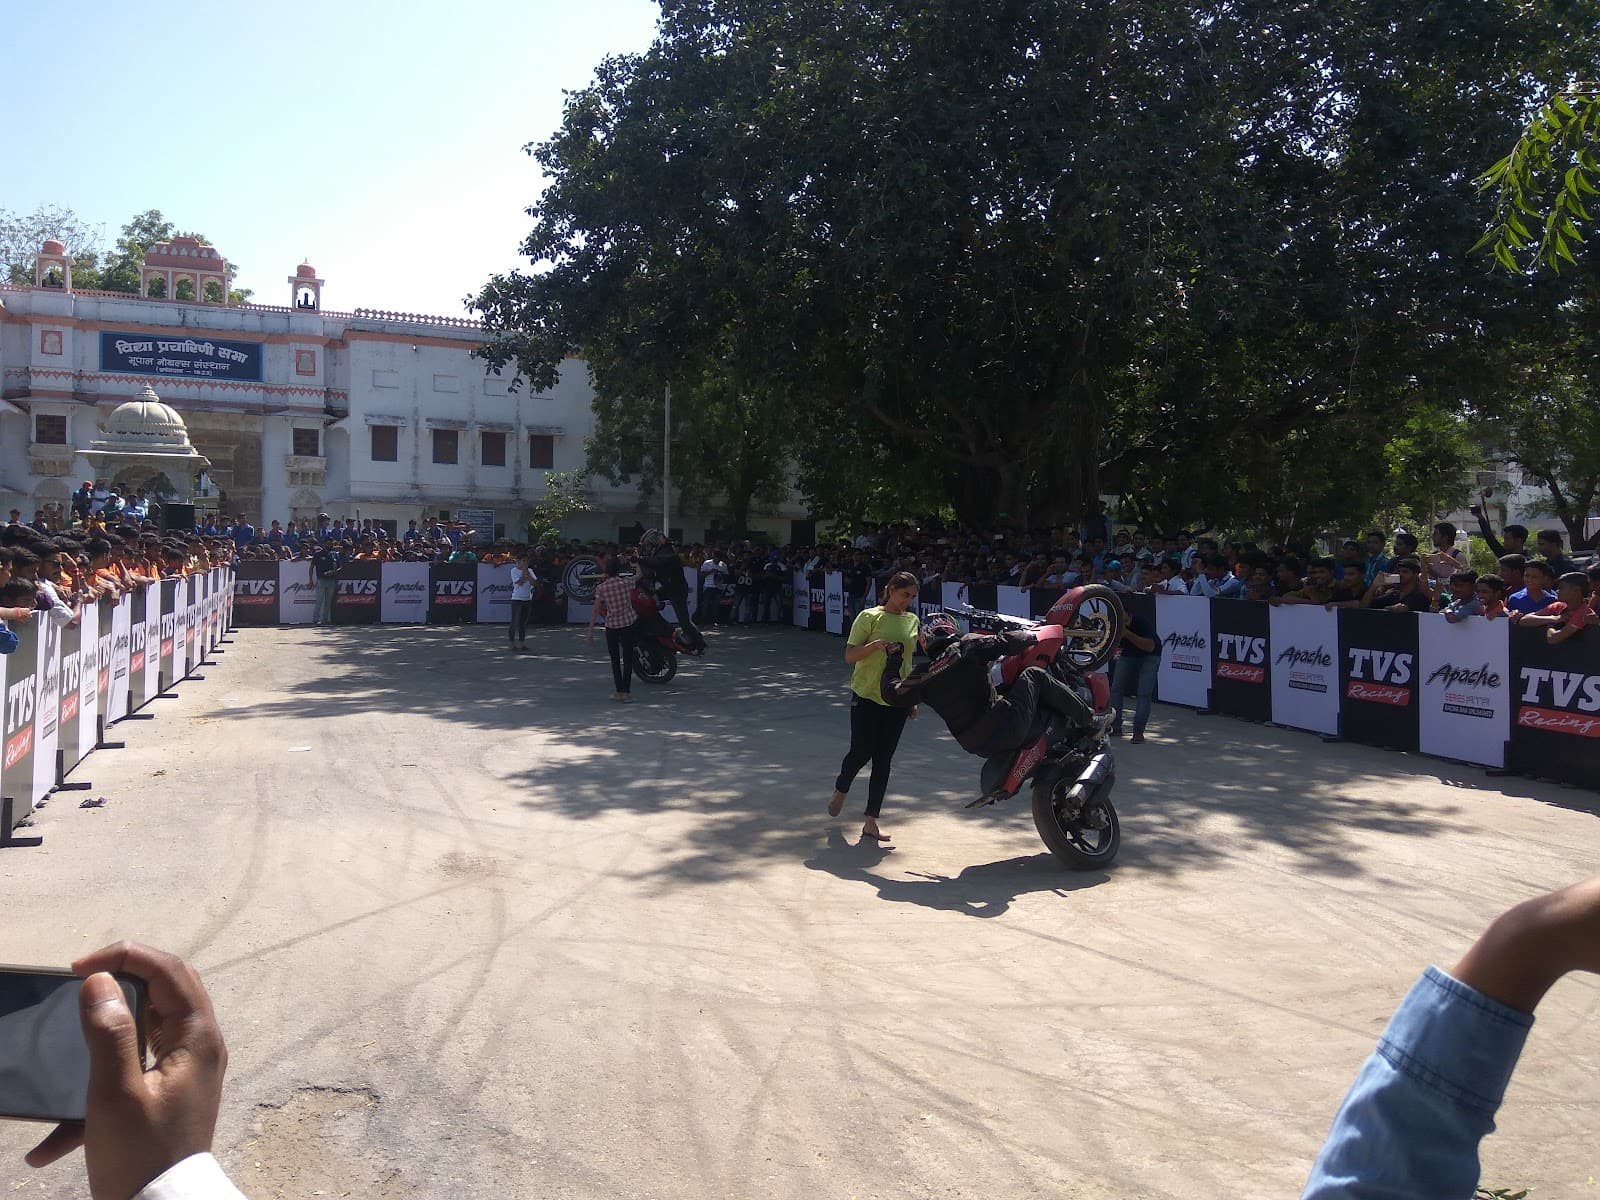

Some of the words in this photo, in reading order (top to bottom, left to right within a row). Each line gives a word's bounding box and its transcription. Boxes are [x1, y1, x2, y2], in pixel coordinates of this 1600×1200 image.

[115, 340, 153, 354] विद्या
[218, 347, 248, 363] सभा
[235, 579, 276, 595] TVS
[337, 579, 378, 595] TVS
[436, 580, 475, 595] TVS
[811, 588, 824, 603] TVS
[1162, 631, 1206, 651] Apache
[1217, 633, 1266, 665] TVS
[1274, 645, 1332, 669] Apache
[1348, 647, 1414, 684] TVS
[62, 650, 80, 697] TVS
[1217, 665, 1264, 681] Racing
[1425, 662, 1500, 689] Apache
[1347, 685, 1409, 703] Racing
[1519, 667, 1600, 712] TVS
[7, 673, 36, 735] TVS
[1519, 710, 1600, 734] Racing
